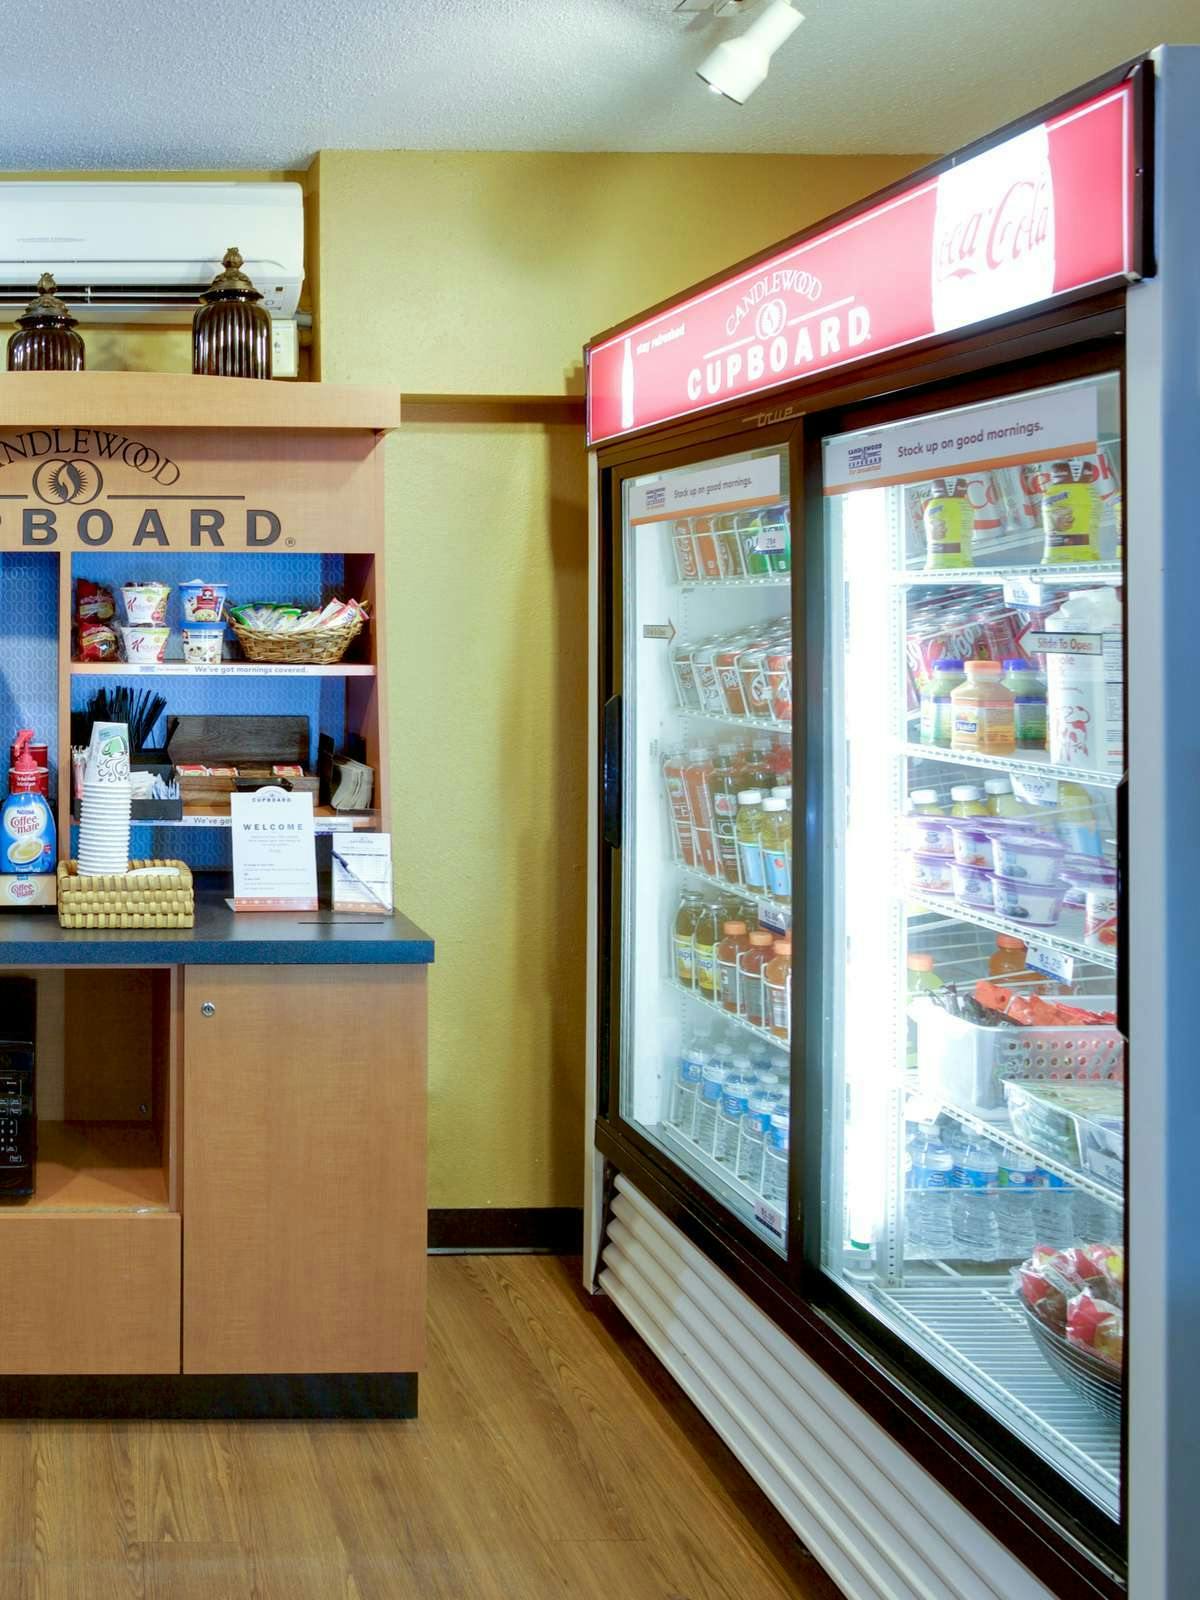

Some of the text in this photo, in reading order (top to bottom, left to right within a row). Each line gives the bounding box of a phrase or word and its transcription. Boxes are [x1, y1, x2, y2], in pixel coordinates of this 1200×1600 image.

[725, 269, 822, 336] CANDLEWOOD
[687, 306, 870, 400] CUPBOARD
[897, 420, 1044, 458] Stock up on good mornings.
[0, 508, 283, 546] BOARD
[11, 816, 37, 829] Coffee
[243, 823, 304, 831] WELCOME
